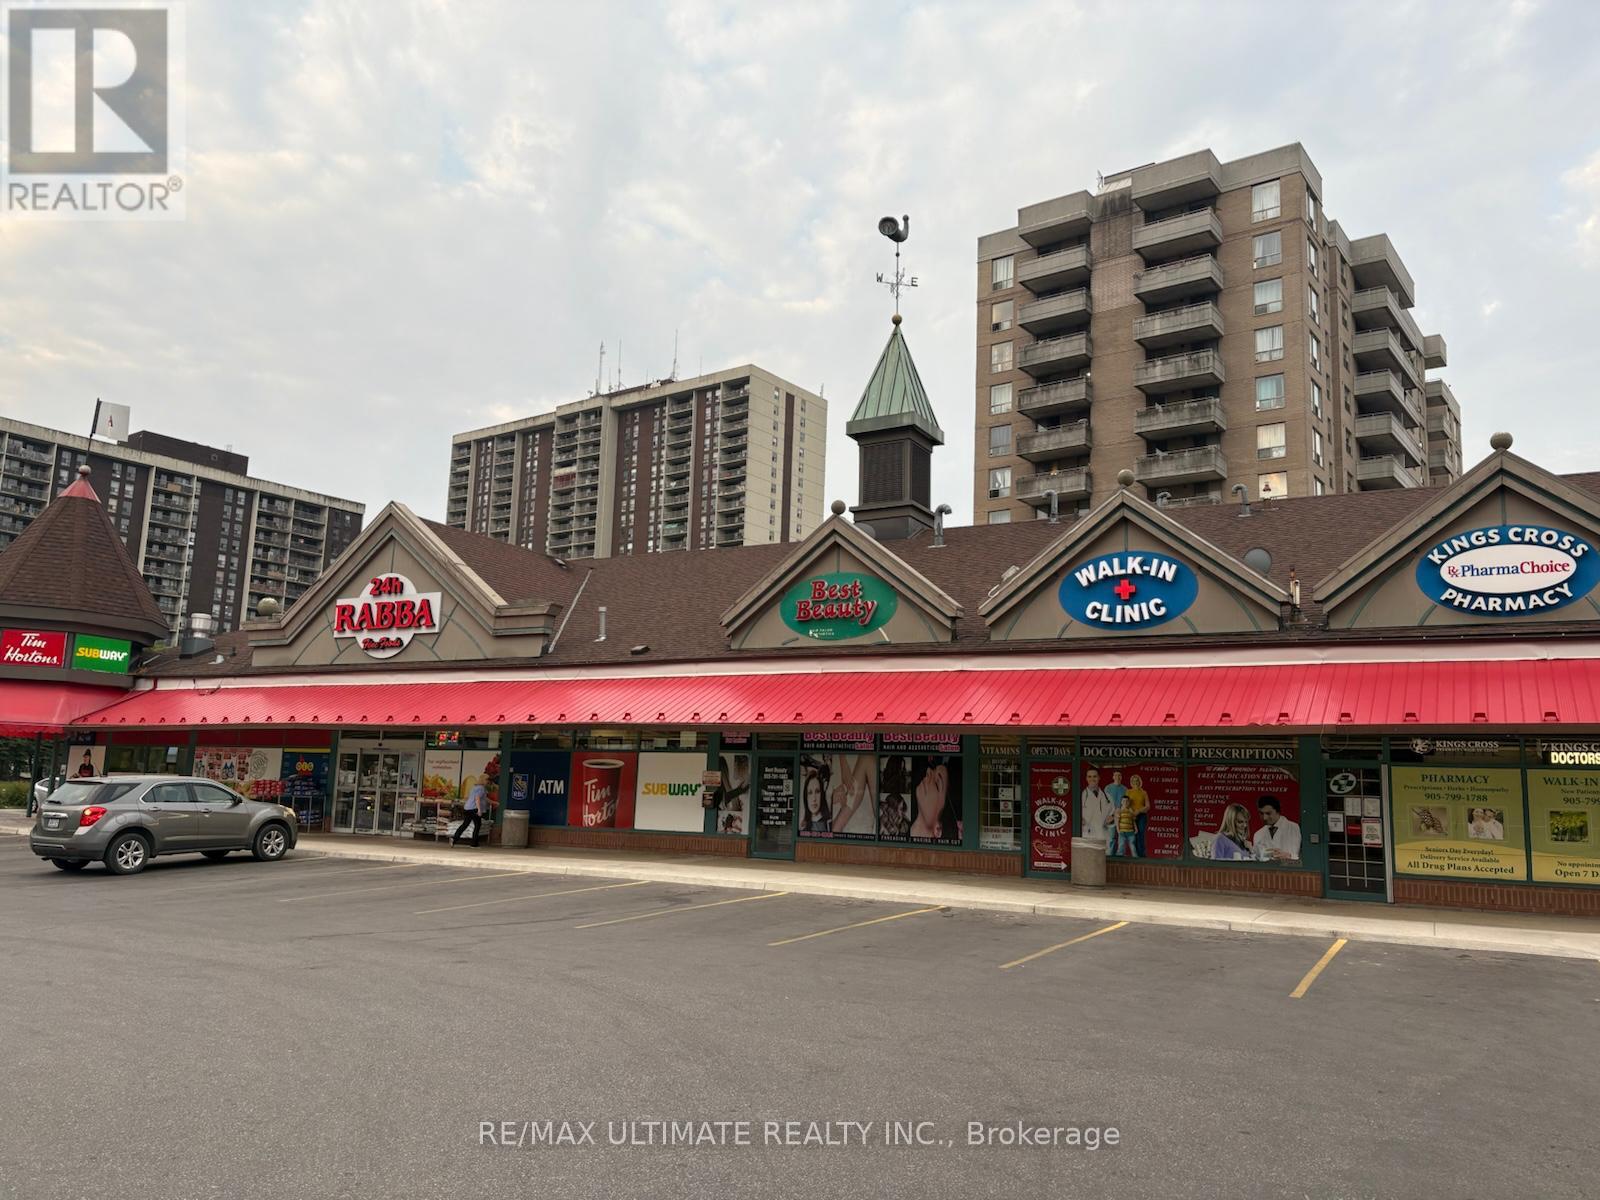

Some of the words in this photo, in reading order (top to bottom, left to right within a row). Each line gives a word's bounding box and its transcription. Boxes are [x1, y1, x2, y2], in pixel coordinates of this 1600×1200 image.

[911, 277, 919, 287] E
[1427, 528, 1501, 565] KINGS
[1508, 527, 1589, 558] CROSS
[1074, 556, 1178, 587] WALK-IN
[1461, 560, 1570, 577] PharmaChoice
[369, 577, 404, 596] 24h
[811, 580, 863, 600] Best
[1440, 582, 1574, 612] PHARMACY
[334, 599, 435, 632] RABBA
[796, 599, 878, 626] Beauty
[1085, 598, 1167, 623] CLINIC
[20, 633, 48, 648] Tim
[76, 647, 128, 661] SUBWAY
[981, 746, 1020, 755] VITAMINS
[1436, 740, 1466, 748] KINGS
[1551, 743, 1588, 751] KINGS
[1032, 747, 1049, 755] OPEN
[1054, 747, 1071, 756] DAYS
[1083, 746, 1136, 757] DOCTORS
[1138, 747, 1181, 757] OFFICE
[1191, 747, 1293, 759] PRESCRIPTIONS
[1551, 752, 1600, 765] DOCTORS
[1421, 774, 1489, 783] PHARMACY
[1543, 777, 1598, 786] WALK-IN
[538, 779, 565, 795] ATM
[584, 778, 610, 804] Tim
[642, 783, 701, 796] SUBWAY
[1034, 797, 1068, 808] WALK-IN
[1425, 793, 1488, 802] 905-799-1788
[1035, 826, 1067, 837] CLINIC
[1471, 856, 1499, 864] Available
[1407, 860, 1420, 868] All
[1422, 862, 1445, 871] Drug
[1447, 863, 1471, 871] Plans
[1474, 865, 1514, 875] Accepted
[1555, 869, 1581, 878] Open
